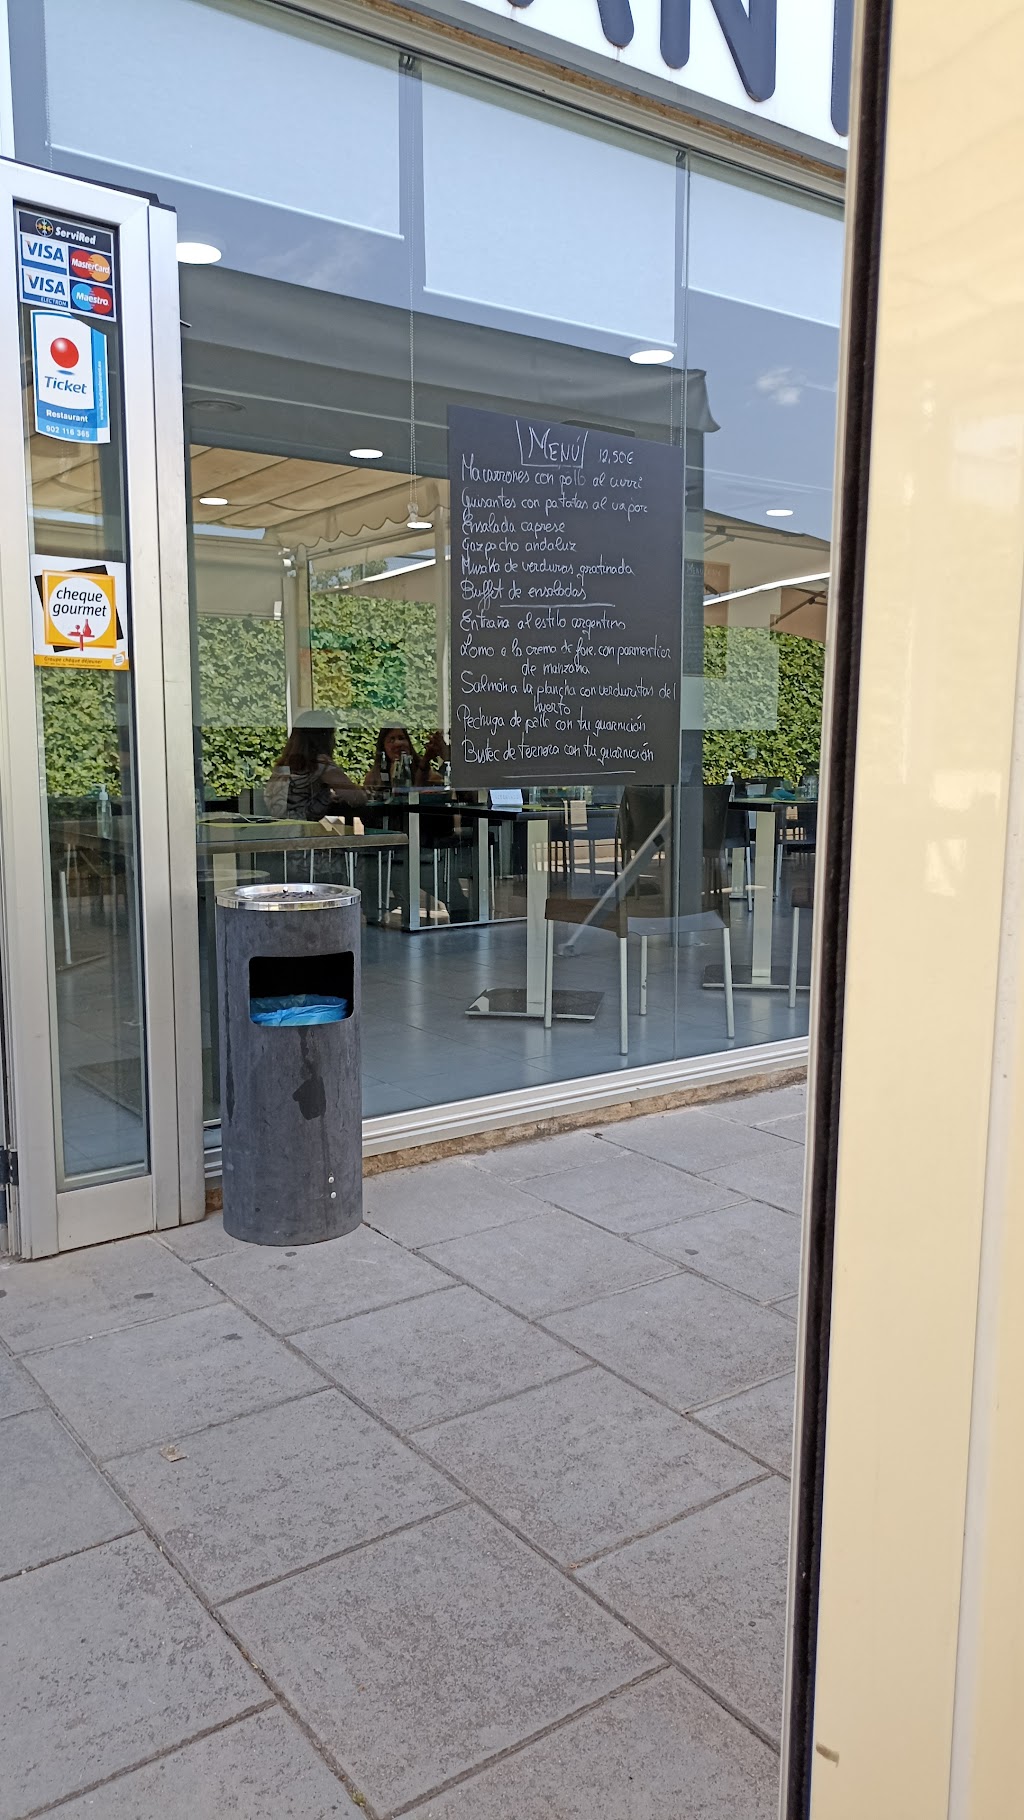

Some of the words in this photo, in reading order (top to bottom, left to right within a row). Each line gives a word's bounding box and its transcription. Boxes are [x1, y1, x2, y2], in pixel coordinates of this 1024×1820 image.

[55, 226, 96, 245] ServiRed
[25, 239, 64, 263] VISA
[71, 258, 110, 274] MasterCard
[26, 273, 66, 296] VISA
[76, 291, 109, 306] Maestro
[44, 375, 87, 395] Ticket
[46, 409, 88, 423] Restaurant
[45, 424, 60, 433] 902
[461, 453, 530, 483] Macarrones
[535, 471, 554, 485] con
[593, 471, 605, 487] al
[521, 498, 540, 509] con
[546, 492, 589, 516] patatas
[592, 496, 607, 511] al
[461, 512, 516, 535] Ensalada
[521, 521, 565, 539] caprese
[461, 537, 519, 560] Gazpacho
[525, 537, 577, 552] andaluz
[505, 558, 518, 572] de
[522, 559, 574, 575] verduras
[577, 554, 635, 586] gratinada
[56, 586, 103, 604] cheque
[460, 577, 503, 611] Buffet
[508, 580, 522, 600] de
[528, 580, 587, 600] ensaladas
[52, 603, 107, 617] gourmet
[517, 611, 533, 629] al
[535, 608, 566, 629] estilo
[460, 633, 495, 658] Lomo
[511, 637, 522, 657] la
[525, 645, 557, 656] crema
[561, 639, 573, 654] de
[598, 645, 615, 657] con
[521, 657, 537, 677] de
[543, 661, 590, 675] manzana
[510, 684, 518, 694] a
[522, 677, 533, 695] la
[579, 685, 596, 697] con
[658, 682, 677, 701] del
[457, 704, 504, 735] Pechuga
[509, 710, 522, 728] de
[555, 716, 573, 731] con
[577, 706, 591, 731] tu
[503, 739, 517, 760] de
[564, 744, 581, 758] con
[583, 735, 597, 758] tu
